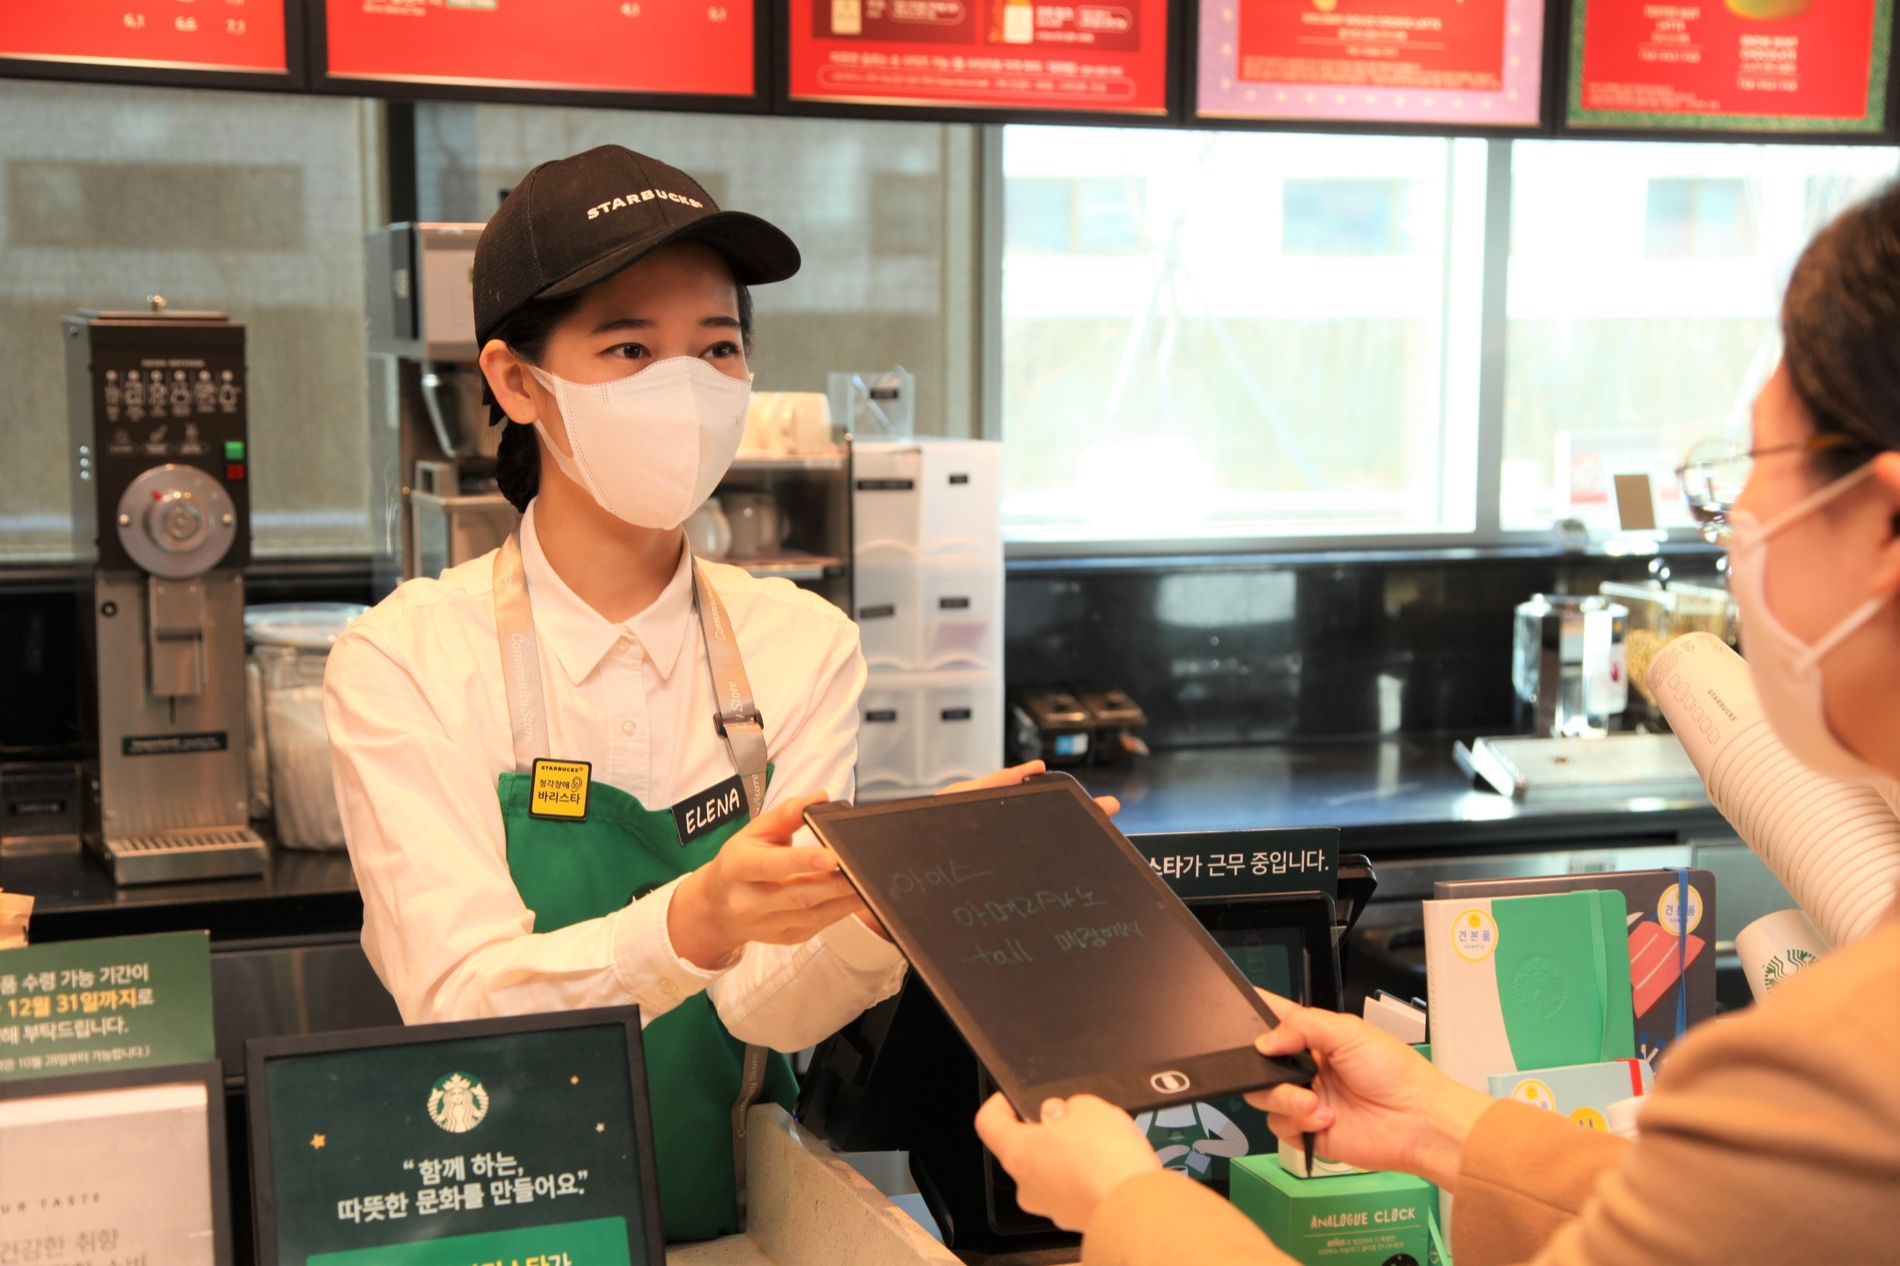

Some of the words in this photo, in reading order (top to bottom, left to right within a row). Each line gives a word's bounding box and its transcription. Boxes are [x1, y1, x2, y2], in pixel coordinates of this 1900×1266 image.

[538, 791, 580, 805] 바리스타
[539, 779, 570, 790] 청각장애
[685, 788, 740, 835] ELENA
[893, 861, 993, 893] 아이스
[1207, 853, 1245, 877] 근무
[1250, 849, 1329, 876] 중입니다.
[952, 887, 1110, 926] 아메리카노
[961, 938, 1033, 966] tall
[21, 970, 57, 993] 수령
[60, 969, 95, 989] 가능
[99, 963, 150, 984] 기간이
[8, 995, 51, 1018] 12월
[56, 988, 154, 1014] 31일까지로
[23, 1015, 130, 1044] 부탁드립니다.
[470, 1152, 524, 1178] 하는,
[41, 1192, 100, 1211] TASTE
[337, 1191, 408, 1224] 따뜻한
[416, 1184, 484, 1216] 문화를
[1310, 1212, 1368, 1229] ANALOGUE
[1374, 1207, 1415, 1224] CLOCK
